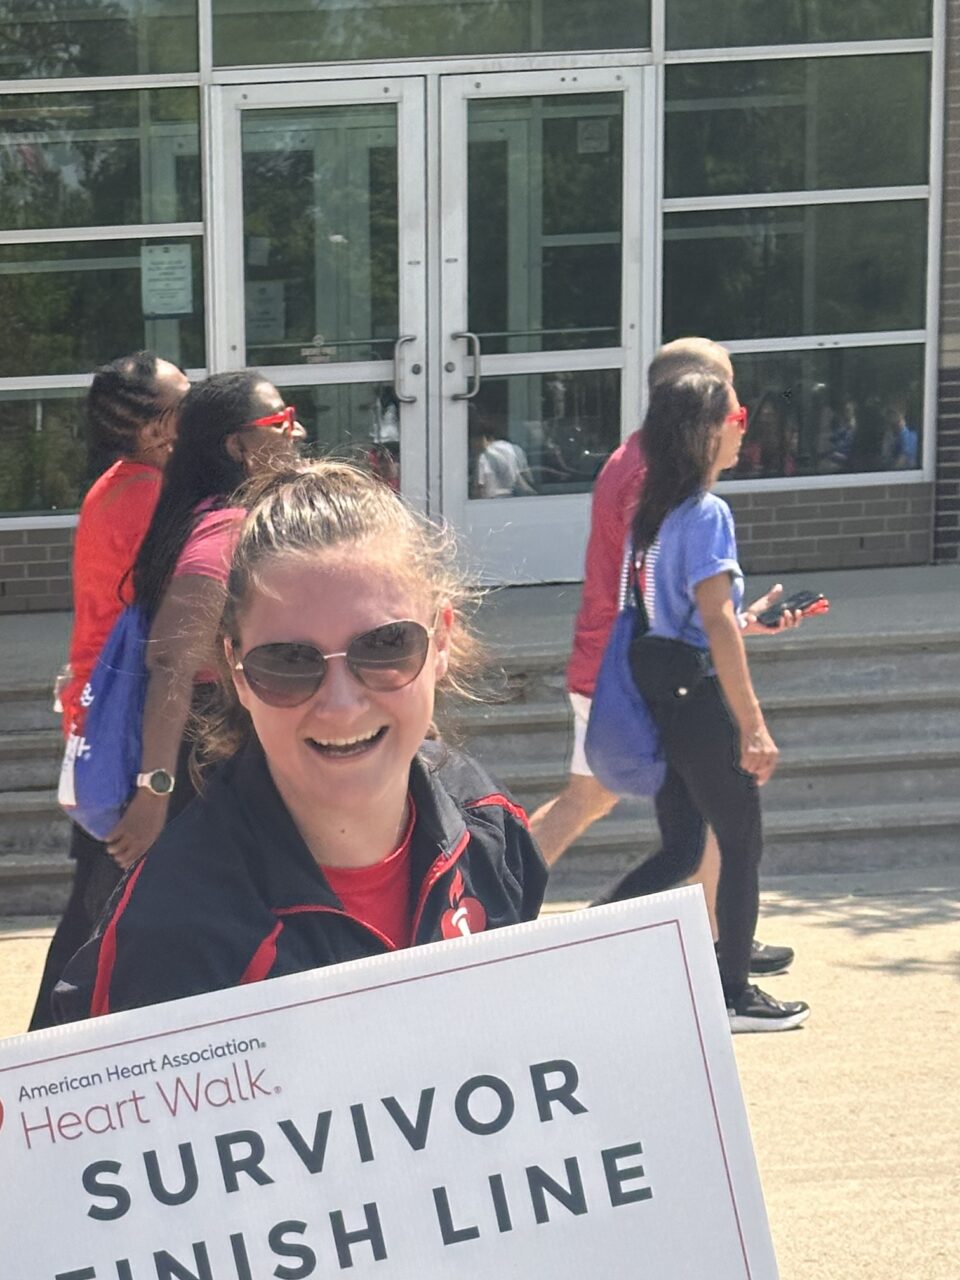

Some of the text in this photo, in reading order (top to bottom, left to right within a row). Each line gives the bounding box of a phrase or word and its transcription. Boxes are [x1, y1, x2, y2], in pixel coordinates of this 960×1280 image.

[19, 1037, 261, 1103] American Heart Association
[20, 1059, 272, 1150] Heart Walk
[81, 1058, 590, 1222] SURVIVOR
[431, 1141, 654, 1247] LINE
